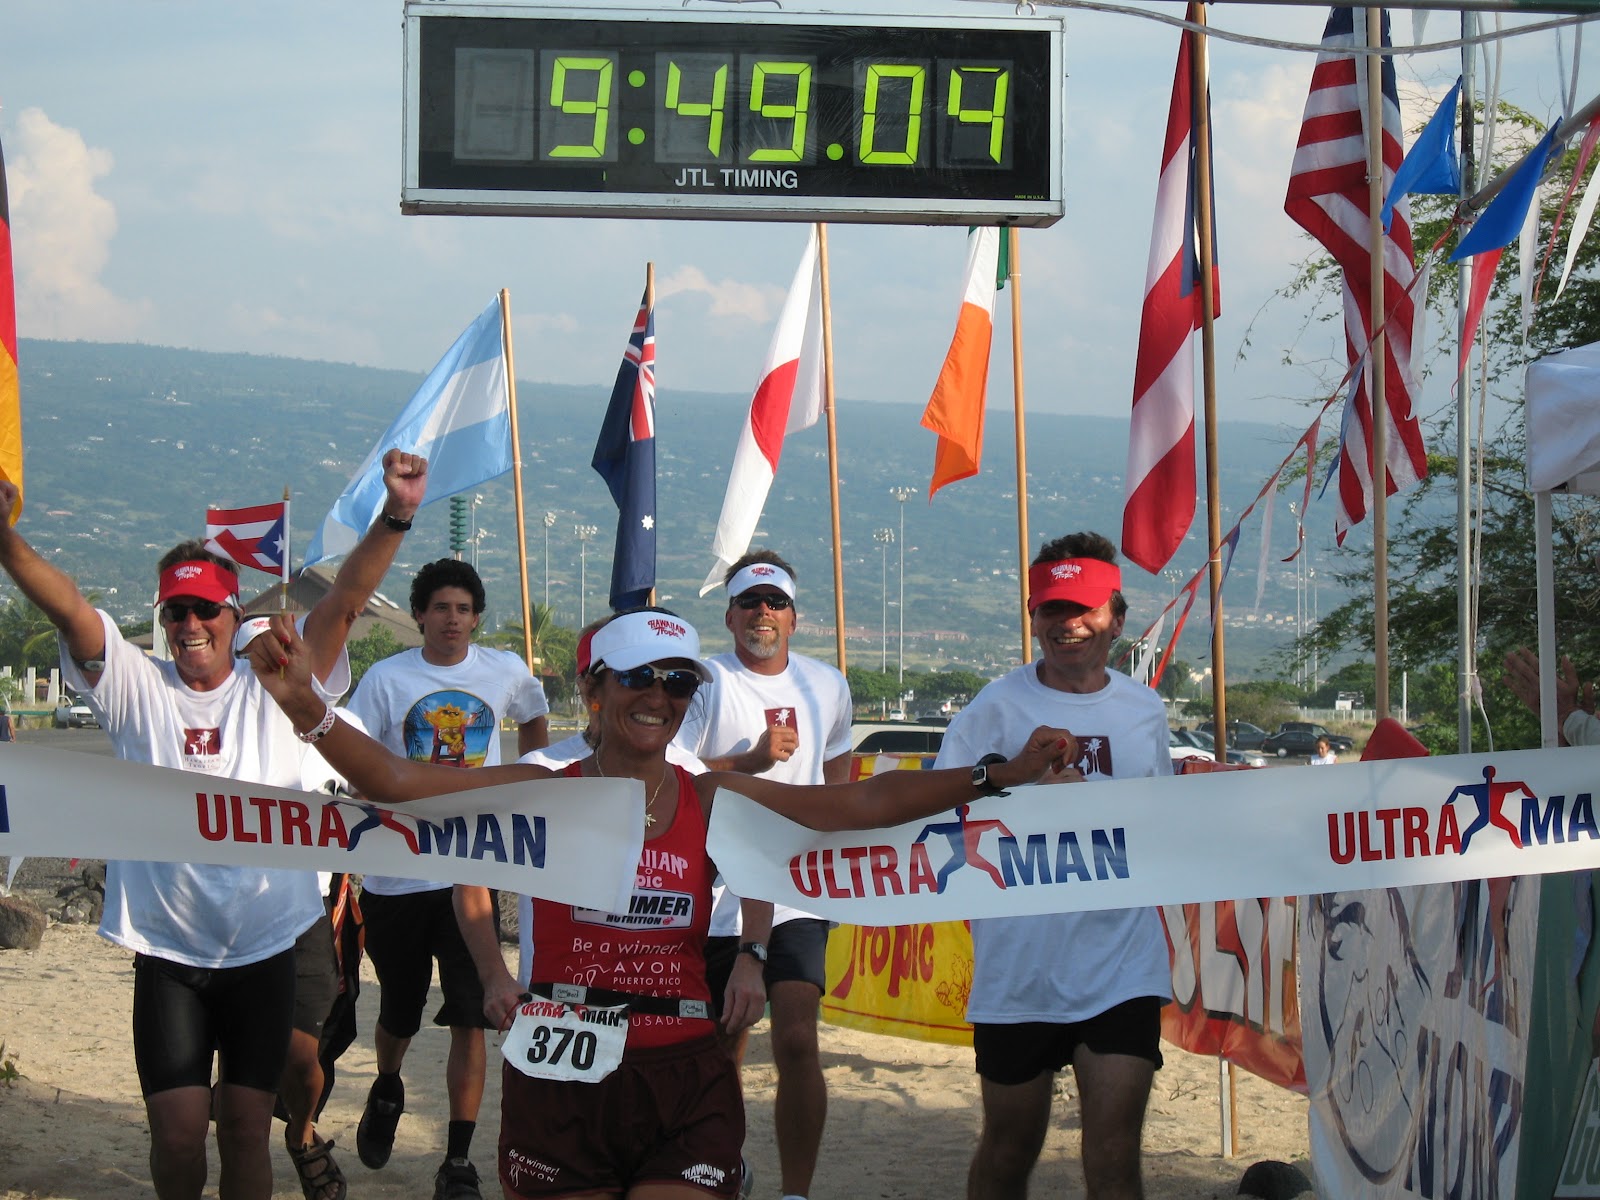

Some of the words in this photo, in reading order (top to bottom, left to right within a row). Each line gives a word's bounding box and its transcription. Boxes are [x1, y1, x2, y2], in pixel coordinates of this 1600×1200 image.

[548, 56, 1009, 165] 9:49.04
[674, 168, 715, 187] JTL
[719, 168, 798, 189] TIMING
[647, 618, 687, 637] HAWAIIAN
[652, 626, 680, 637] Tropic
[195, 792, 350, 849] ULTRA
[416, 813, 547, 869] MAN
[1327, 804, 1464, 865] ULTRA
[1520, 793, 1600, 847] MA
[638, 848, 689, 880] AIIAN
[789, 842, 939, 899] ULTRA
[999, 827, 1130, 888] MAN
[634, 873, 663, 889] pic
[605, 914, 662, 925] NUTRITION
[572, 937, 593, 953] Be
[599, 942, 611, 954] a
[617, 940, 684, 956] winner!
[613, 961, 681, 974] AVON
[613, 976, 654, 986] PUERTO
[658, 977, 682, 986] RICO
[631, 1014, 683, 1028] USADE
[526, 1025, 598, 1072] 370
[508, 1148, 519, 1159] Be
[518, 1155, 526, 1163] a
[526, 1158, 560, 1176] winner!
[523, 1167, 555, 1183] AVON
